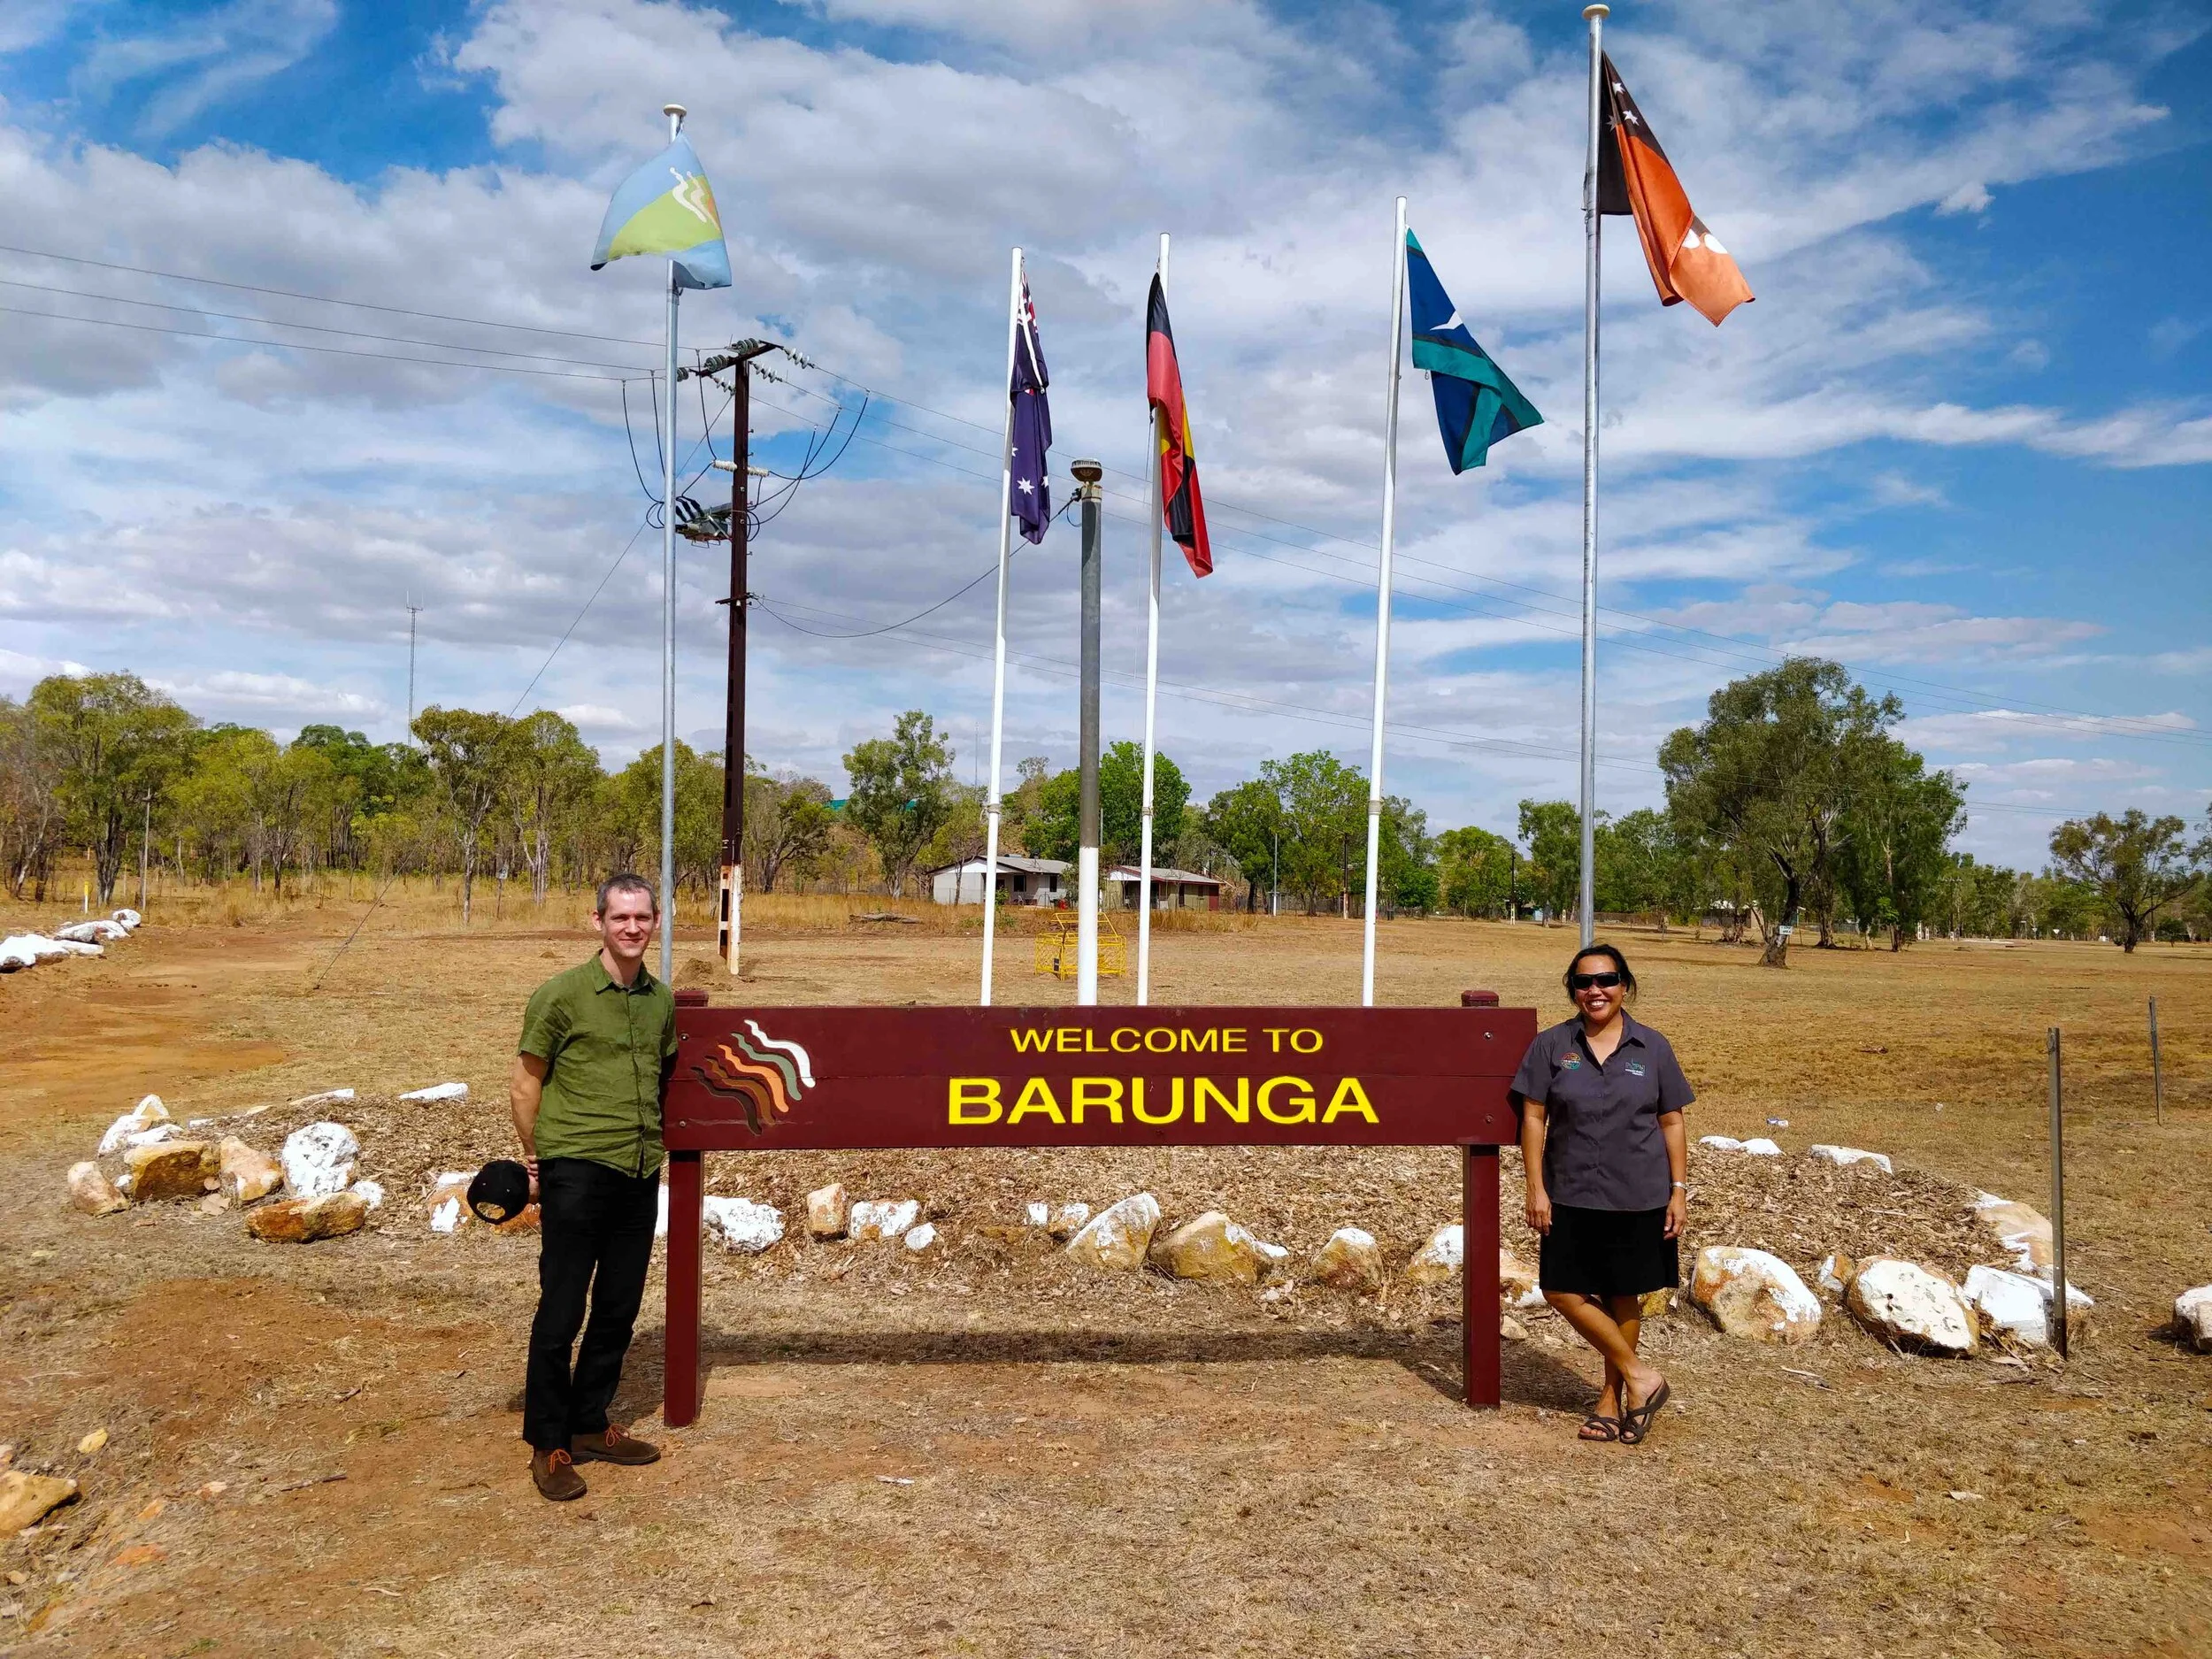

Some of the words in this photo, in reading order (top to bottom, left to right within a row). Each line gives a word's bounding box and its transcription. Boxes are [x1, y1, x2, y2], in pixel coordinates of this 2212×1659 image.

[1010, 1027, 1248, 1053] WELCOME
[1262, 1028, 1324, 1054] TO
[948, 1076, 1380, 1125] BARUNGA
